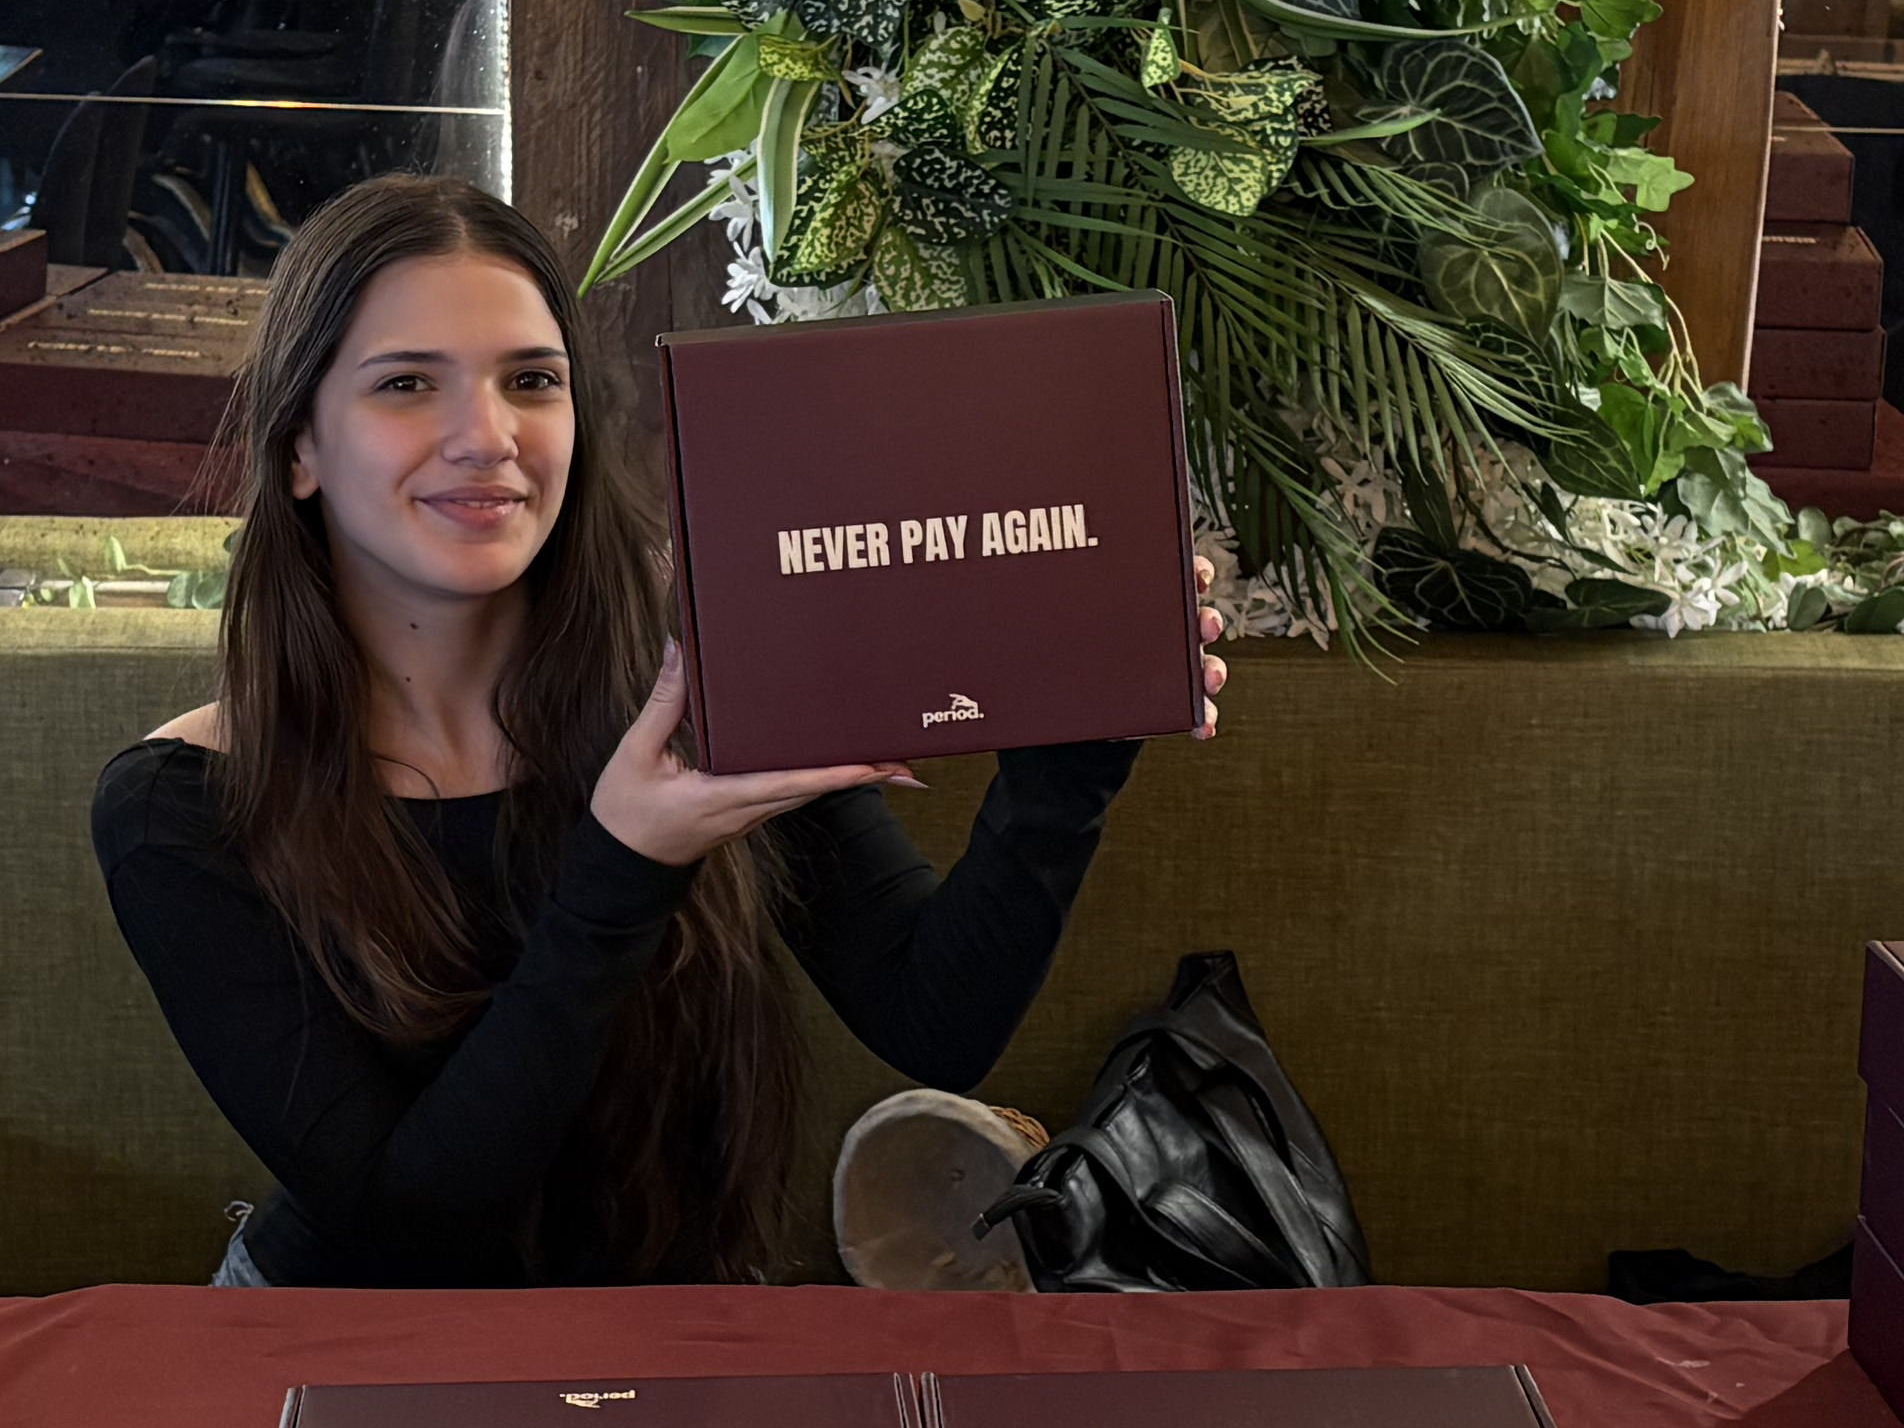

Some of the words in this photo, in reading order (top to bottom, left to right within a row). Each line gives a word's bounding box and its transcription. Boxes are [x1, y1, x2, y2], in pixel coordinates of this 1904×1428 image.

[777, 522, 891, 575] NEVER
[900, 514, 968, 564] PAY
[982, 503, 1099, 557] AGAIN.
[922, 703, 985, 728] period.
